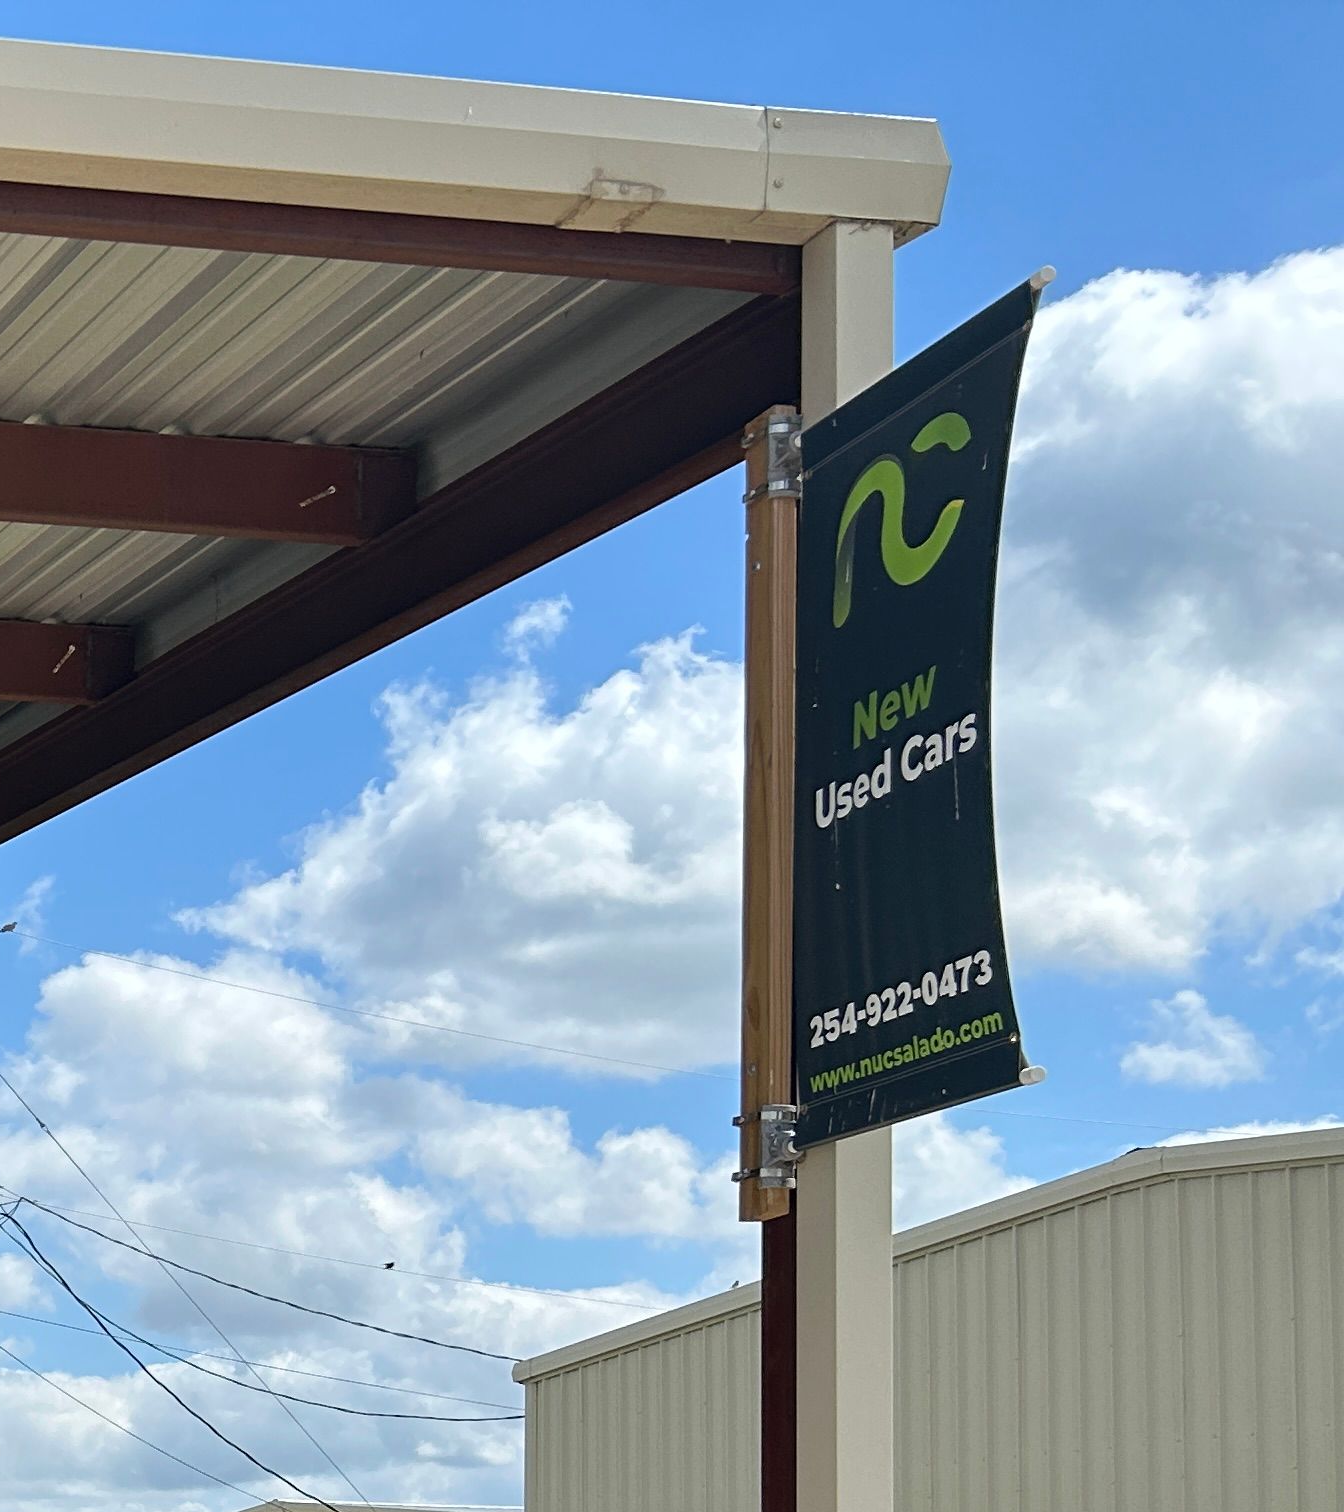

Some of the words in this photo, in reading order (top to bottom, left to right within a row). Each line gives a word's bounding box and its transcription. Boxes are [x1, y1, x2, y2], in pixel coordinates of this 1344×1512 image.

[852, 665, 937, 750] New
[814, 749, 892, 829] Used
[900, 712, 978, 782] Cars
[809, 949, 994, 1050] 254-922-0473
[809, 1011, 1003, 1093] www.nucsalado.com
